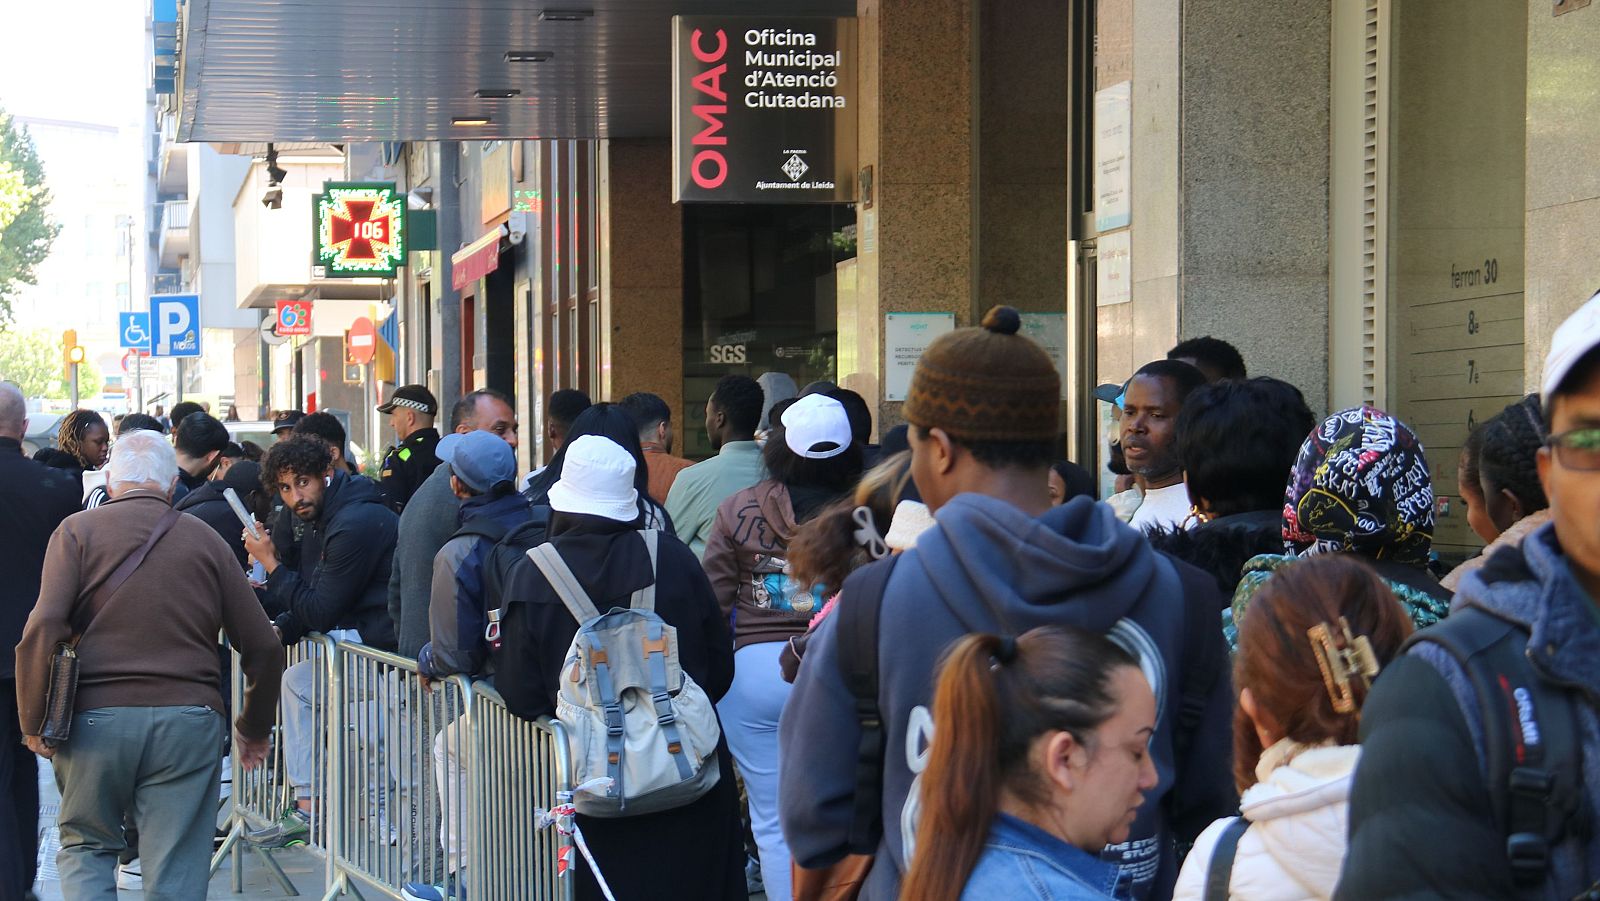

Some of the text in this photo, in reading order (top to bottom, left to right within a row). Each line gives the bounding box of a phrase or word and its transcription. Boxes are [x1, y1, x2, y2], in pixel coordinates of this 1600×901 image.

[744, 29, 816, 46] Oficina
[745, 50, 840, 70] Municipal
[744, 70, 838, 87] d’Atenció
[690, 28, 728, 189] OMAC
[744, 91, 846, 108] Ciutadana
[755, 181, 835, 190] Ajuntament de Lleida
[1451, 258, 1498, 289] ferran 30
[157, 302, 190, 355] P
[710, 345, 746, 364] SGS
